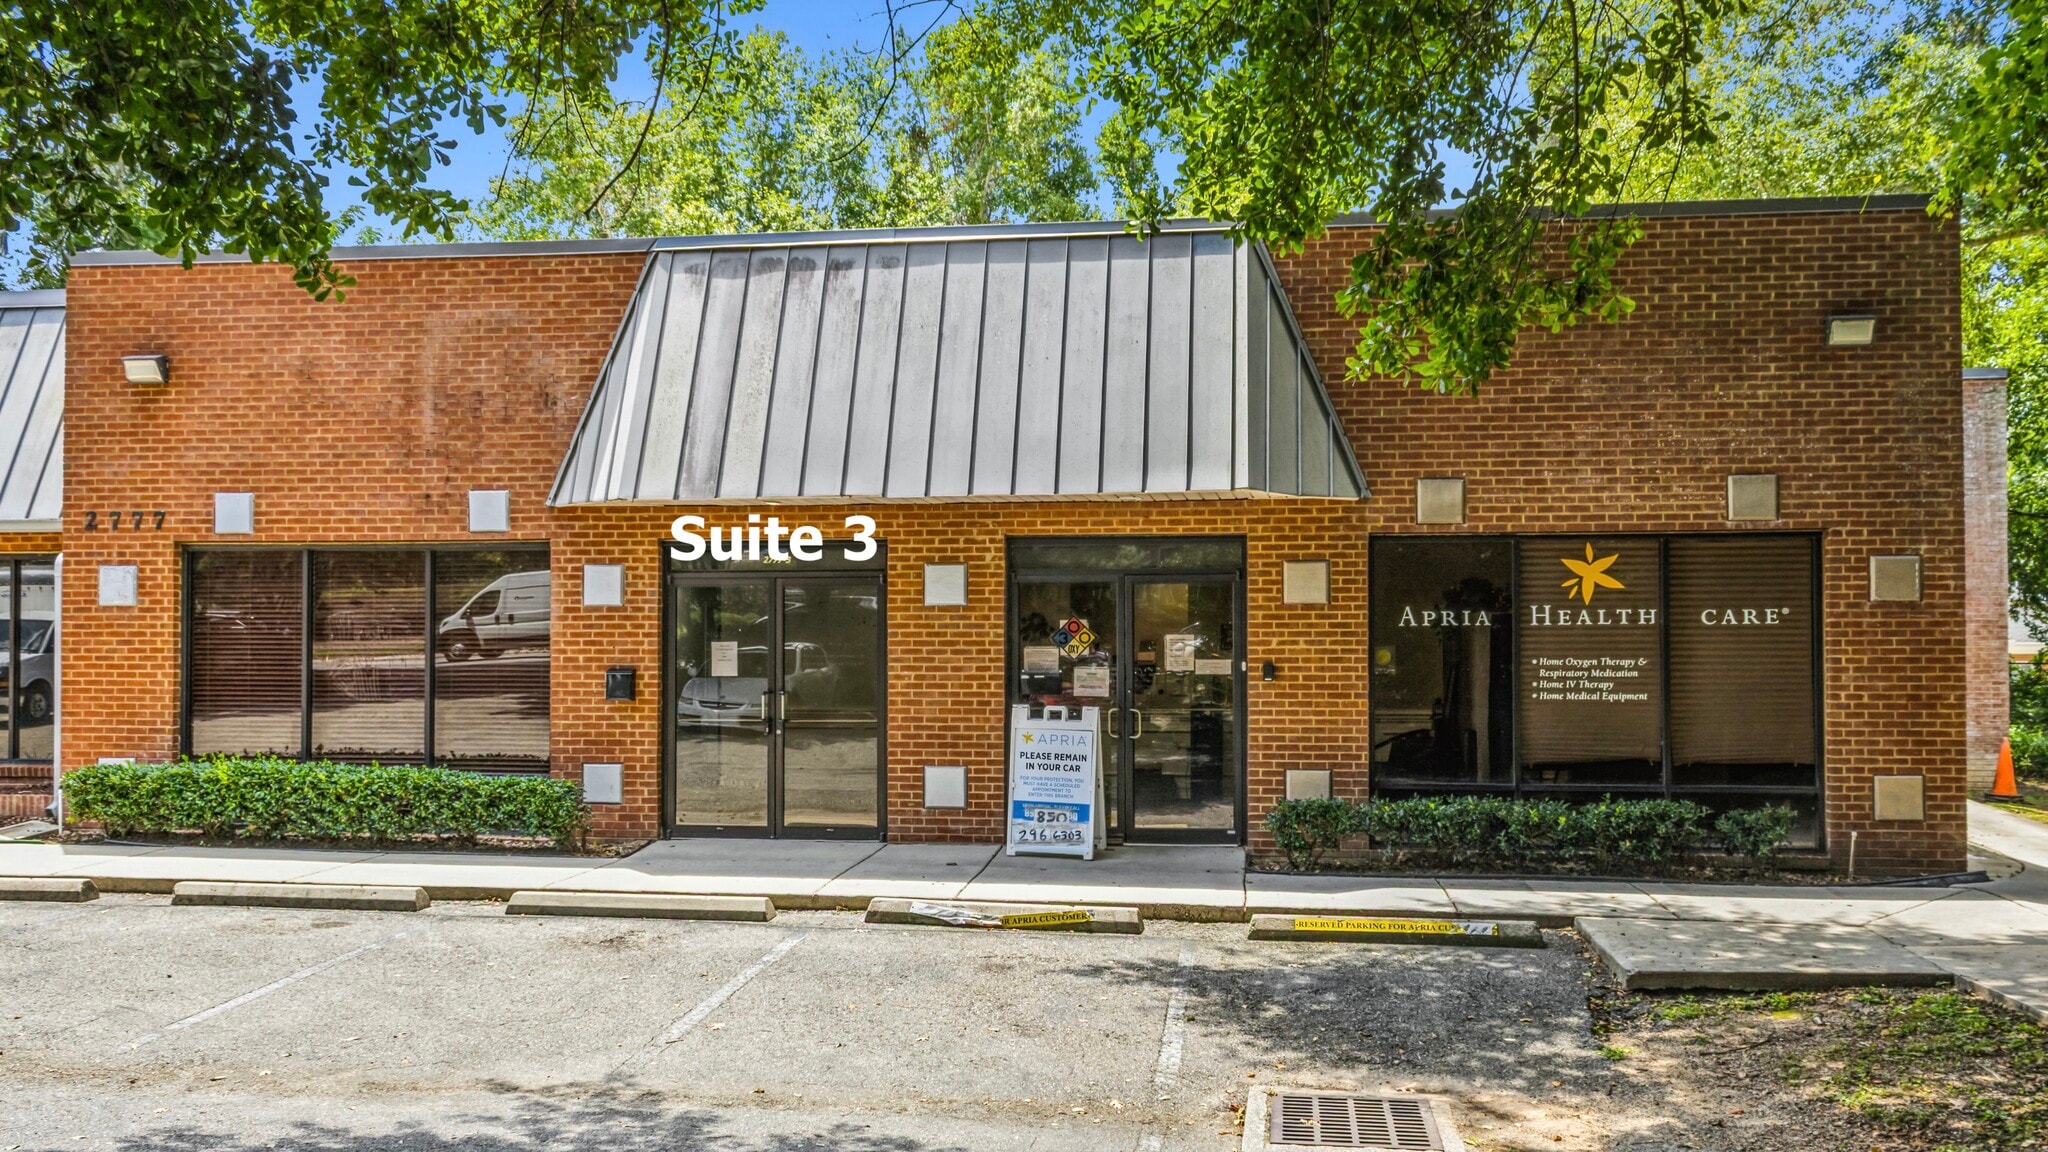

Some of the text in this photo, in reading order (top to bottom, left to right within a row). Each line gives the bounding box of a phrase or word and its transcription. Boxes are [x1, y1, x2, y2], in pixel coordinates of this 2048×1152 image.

[84, 510, 167, 531] 2777
[1398, 606, 1492, 627] APRIA
[1530, 605, 1657, 626] HEALTH
[1058, 632, 1068, 645] 3
[1068, 644, 1080, 654] OXY
[1539, 657, 1648, 668] Home Oxygen Therapy &
[1539, 668, 1638, 679] Respiratory Medication
[1539, 680, 1614, 690] Home IV Therapy
[1539, 691, 1648, 702] Home Medical Equipment
[1037, 733, 1087, 747] APRIA
[1020, 751, 1087, 762] PLEASE REMAIN
[1025, 762, 1081, 772] IN YOUR CAR
[1037, 810, 1068, 823] 850
[1018, 829, 1082, 841] 296 6303
[1012, 916, 1038, 924] APRIA
[1346, 922, 1386, 930] PARKING
